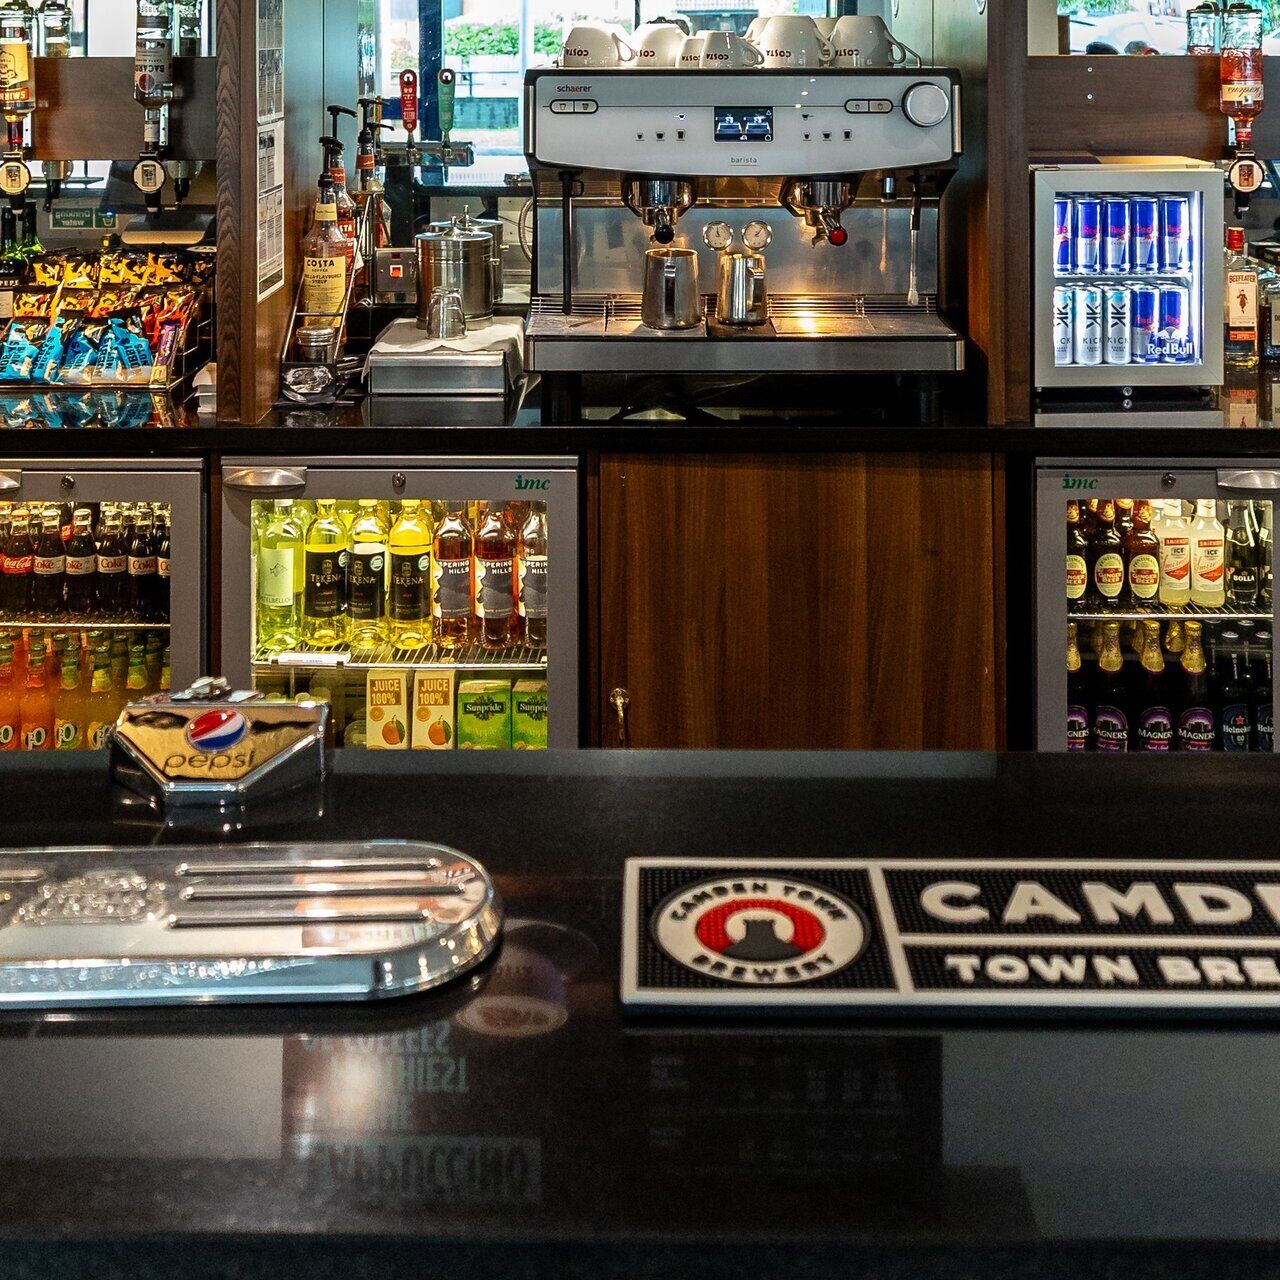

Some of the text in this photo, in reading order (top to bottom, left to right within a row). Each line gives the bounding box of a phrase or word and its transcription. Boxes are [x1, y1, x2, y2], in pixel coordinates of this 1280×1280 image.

[565, 49, 589, 57] COSTA
[706, 52, 729, 60] COSTA
[557, 84, 592, 93] schaerer
[730, 156, 758, 164] barista
[307, 260, 335, 268] COSTA
[1229, 274, 1256, 283] BEEFEATER
[514, 475, 550, 492] imc
[1062, 474, 1098, 489] imc
[373, 679, 399, 691] JUICE
[420, 679, 448, 691] JUICE
[372, 692, 395, 704] 100%
[420, 692, 443, 705] 100%
[467, 702, 501, 712] Sunpride
[1179, 729, 1215, 740] MAGNERS
[163, 750, 256, 772] pepsi
[671, 882, 847, 921] CAMDEN TOWN
[692, 953, 833, 982] BREWERY
[944, 954, 1137, 984] TOWN
